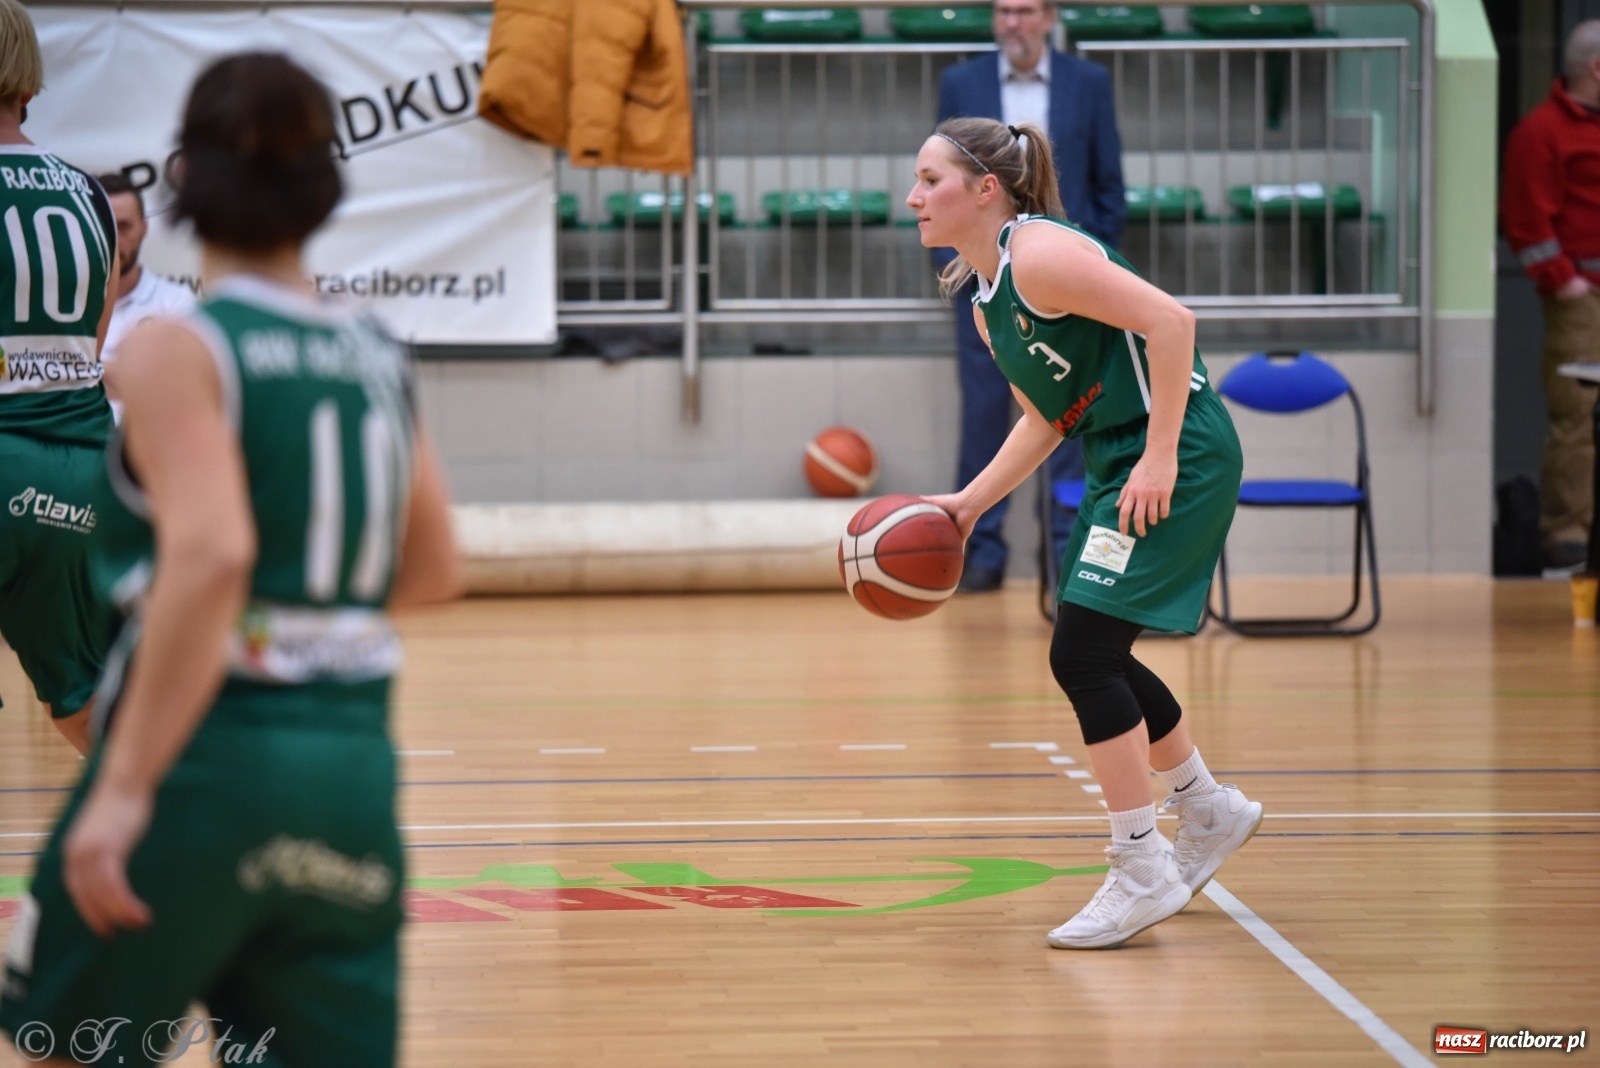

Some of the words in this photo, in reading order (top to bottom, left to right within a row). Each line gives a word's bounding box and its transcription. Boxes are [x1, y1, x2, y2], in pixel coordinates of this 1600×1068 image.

[331, 62, 481, 160] DKU
[4, 204, 90, 323] 10
[1027, 341, 1072, 382] 3
[33, 493, 97, 528] Clavis
[1078, 570, 1116, 587] COLO
